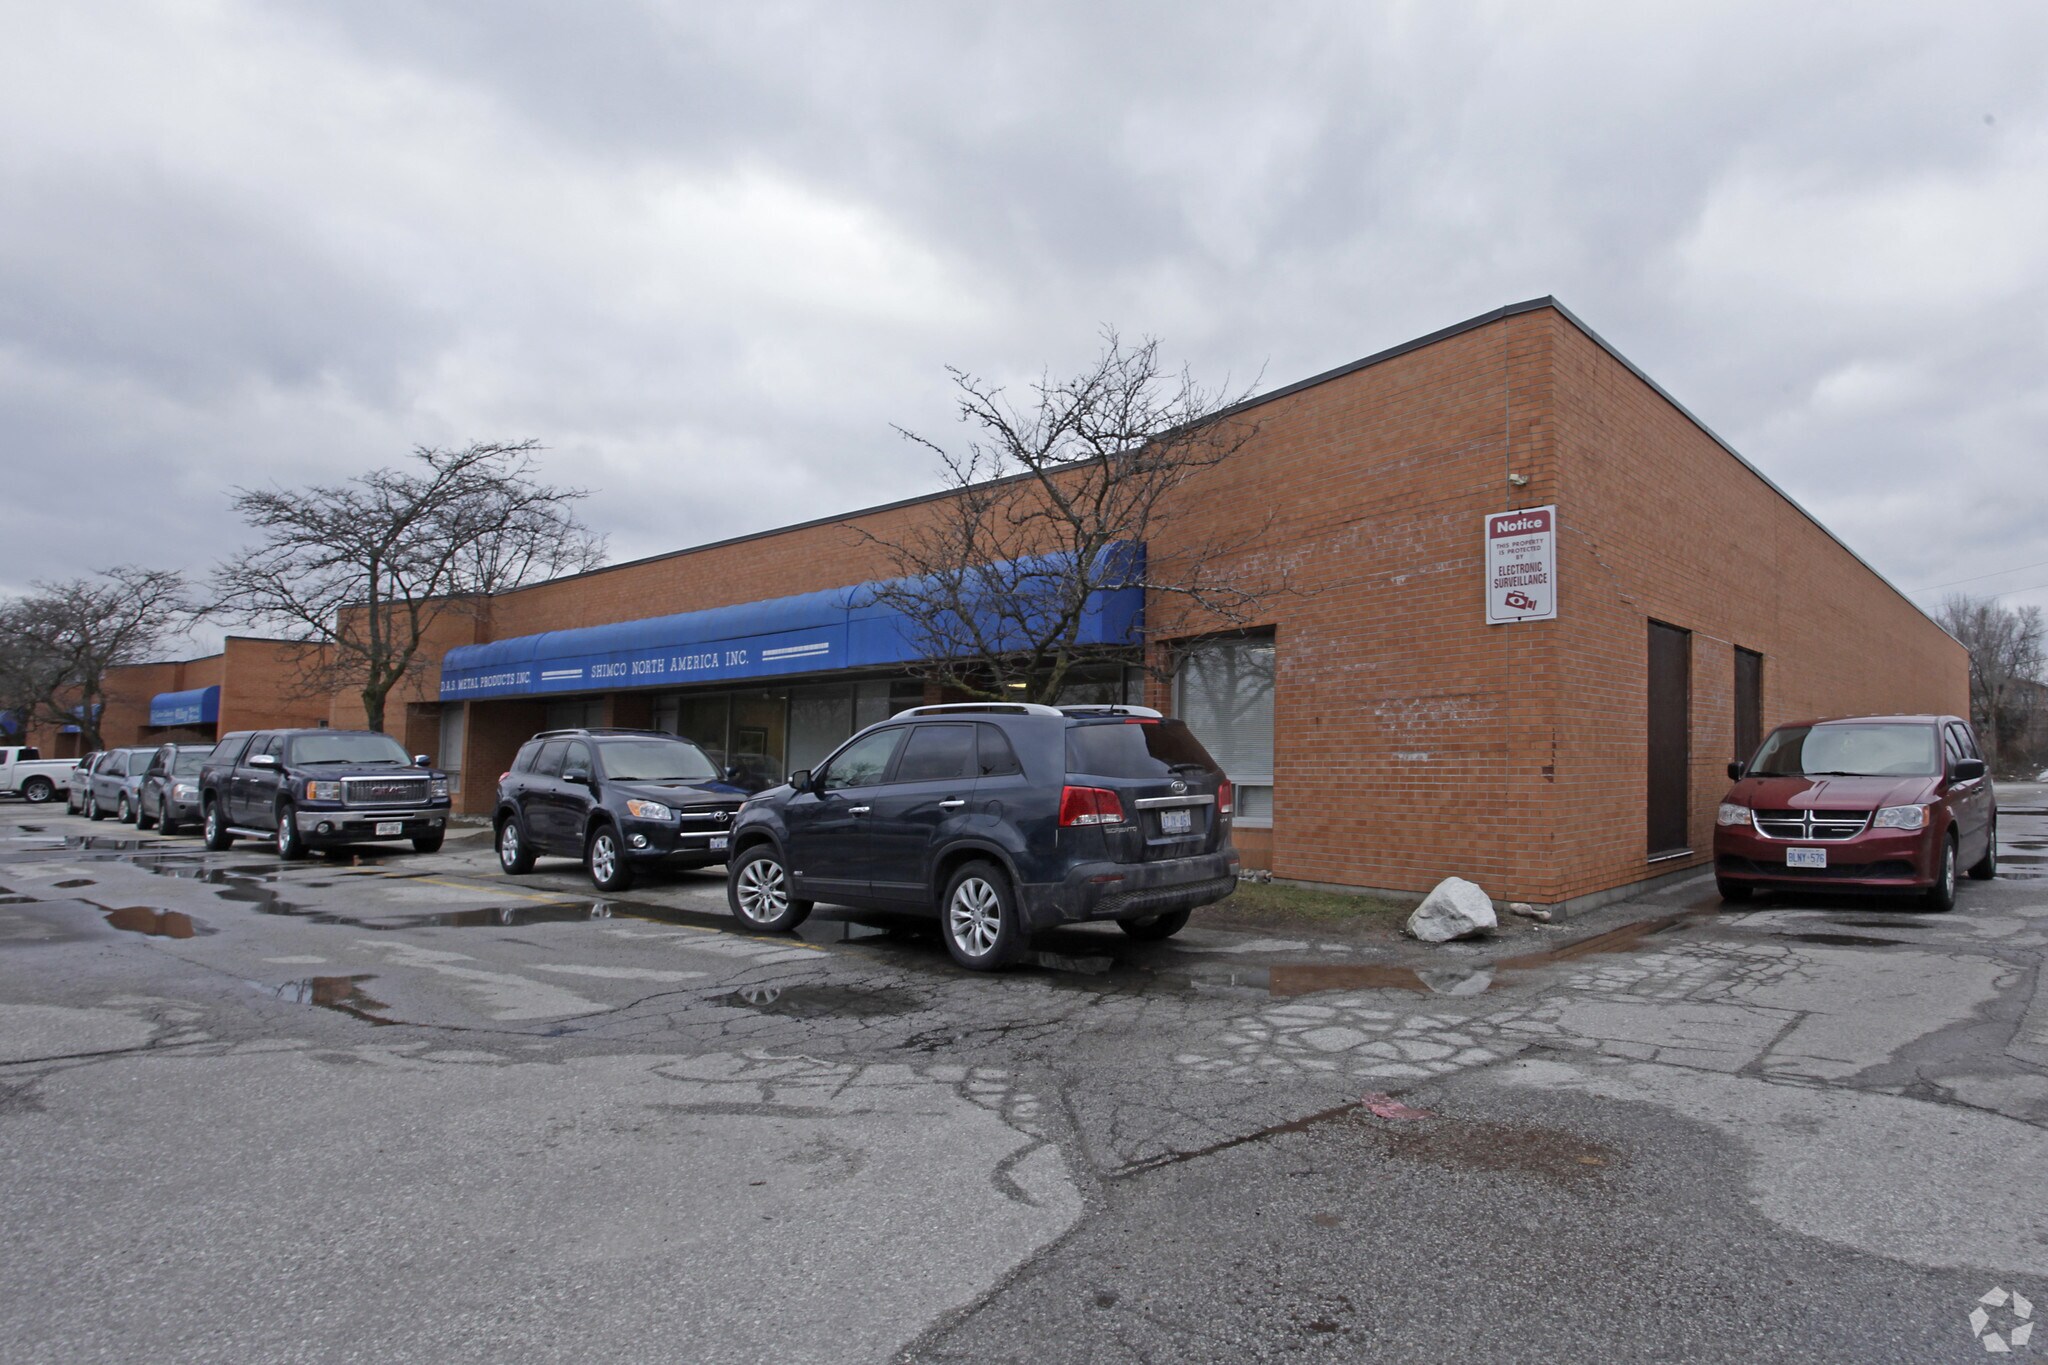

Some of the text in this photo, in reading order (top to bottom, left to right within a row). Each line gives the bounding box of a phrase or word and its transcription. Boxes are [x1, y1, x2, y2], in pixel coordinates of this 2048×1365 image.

[1497, 518, 1543, 533] Notice
[1507, 545, 1541, 554] PROTECTED
[1512, 538, 1544, 547] PROPERTY
[1499, 562, 1542, 576] ELECTRONIC
[1494, 573, 1547, 588] SURVEILLANCE
[591, 650, 749, 678] SHIMCO NORTH AMERICA INC.
[458, 677, 479, 690] METAL
[480, 673, 515, 688] PRODUCTS
[516, 671, 531, 684] INC.
